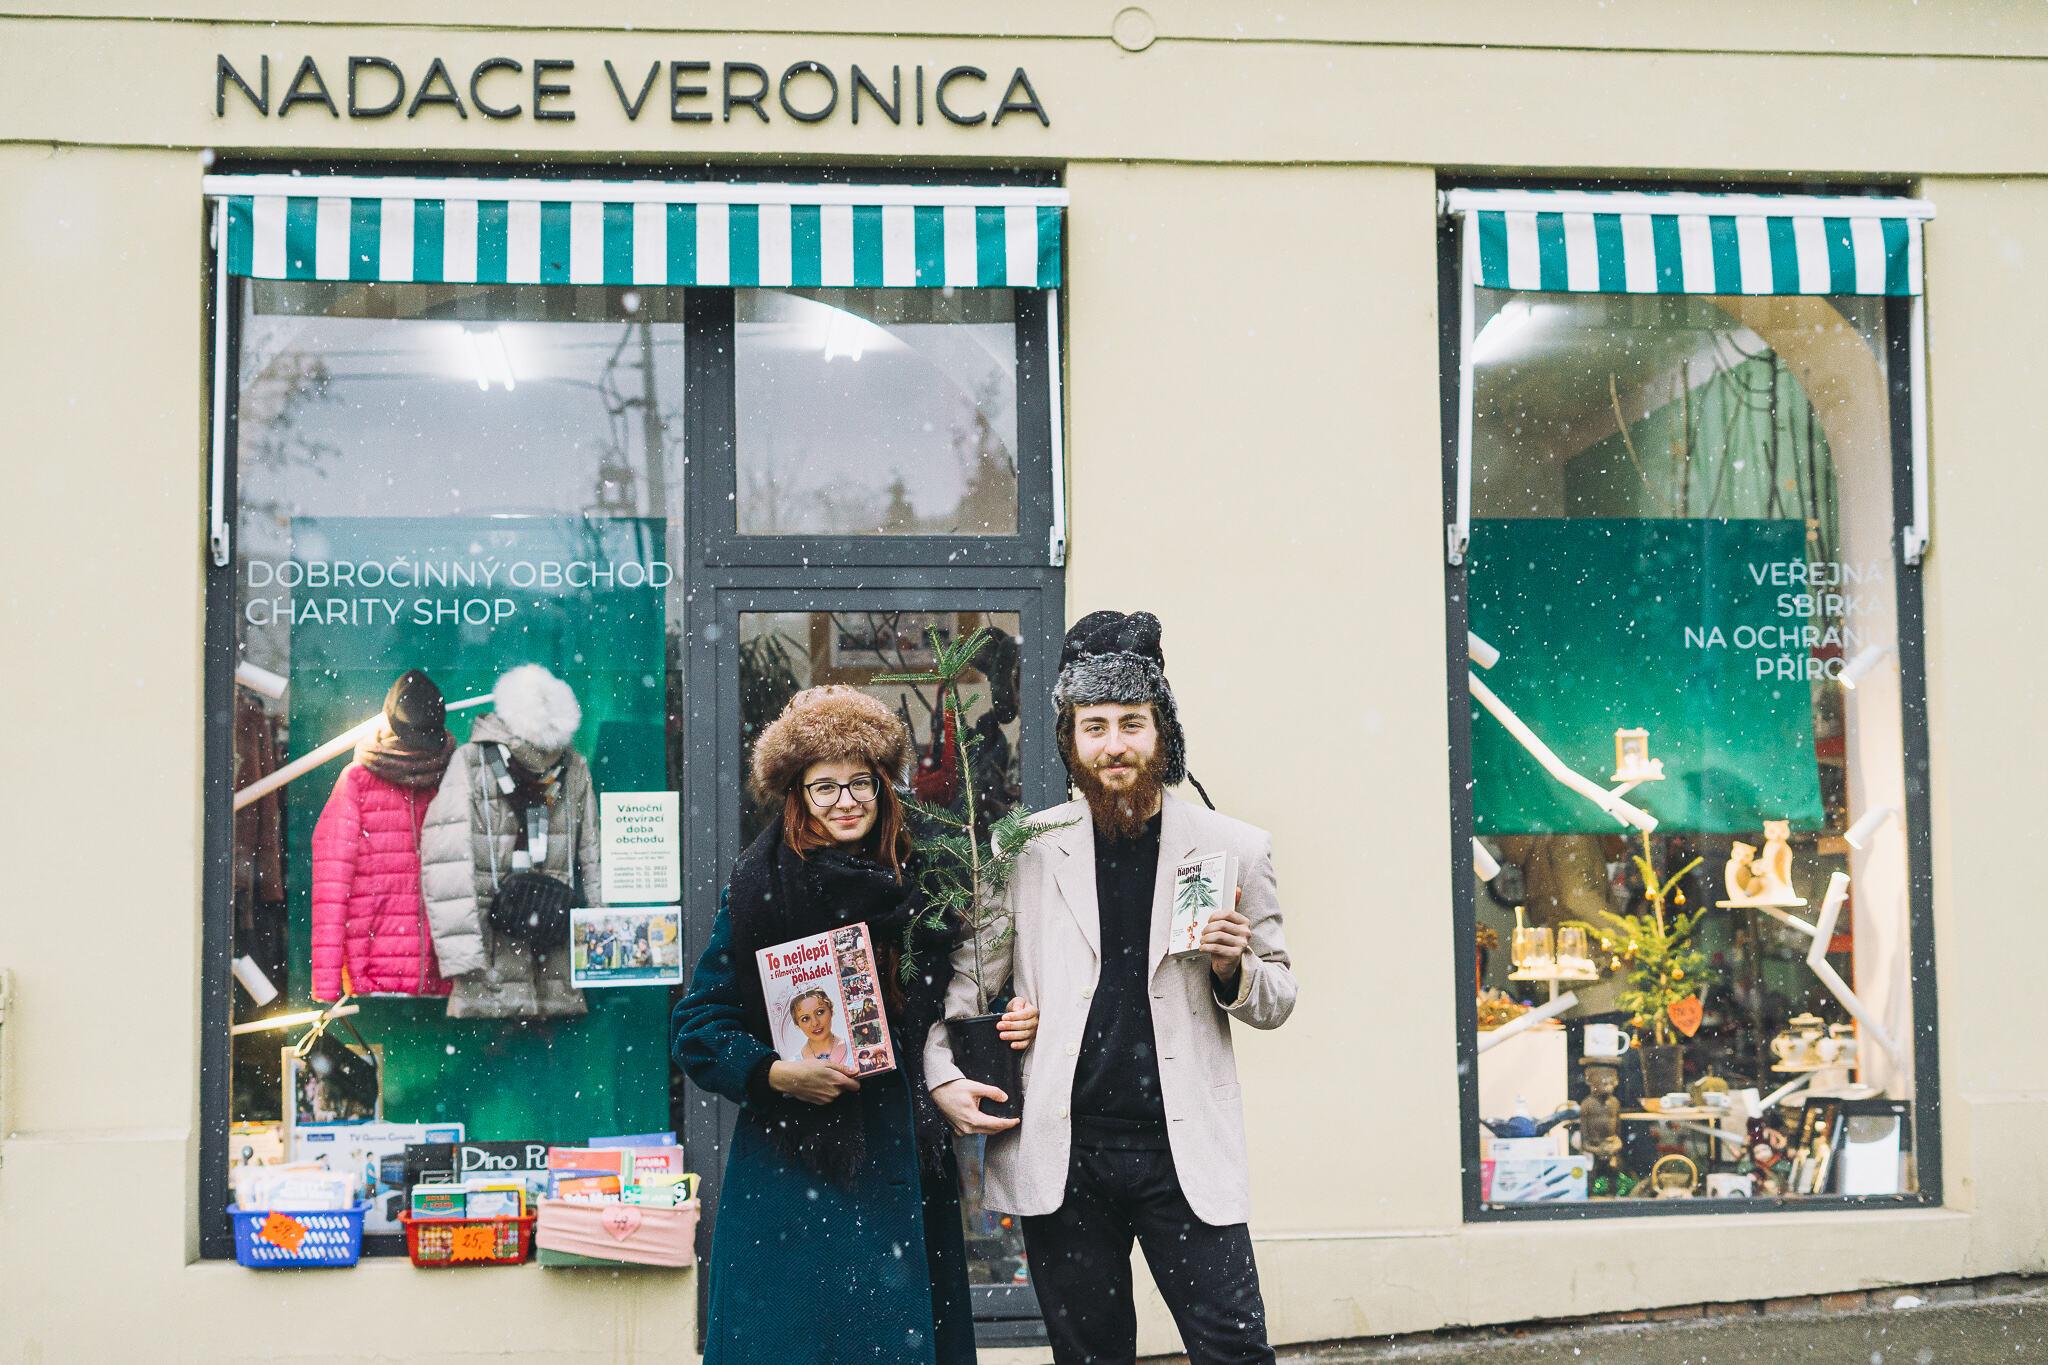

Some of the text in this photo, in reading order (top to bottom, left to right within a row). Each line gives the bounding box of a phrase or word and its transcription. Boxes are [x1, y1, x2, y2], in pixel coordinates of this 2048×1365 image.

[217, 53, 1050, 128] NADACE VERONICA
[246, 556, 674, 589] DOBROČINNÝ OBCHOD
[244, 597, 518, 626] CHARITY SHOP
[1684, 625, 1728, 650] NA
[615, 835, 665, 845] obchodu
[626, 825, 655, 834] doba
[765, 938, 830, 971] To nejlepší
[791, 961, 833, 987] pohádek
[460, 1146, 518, 1171] Dino
